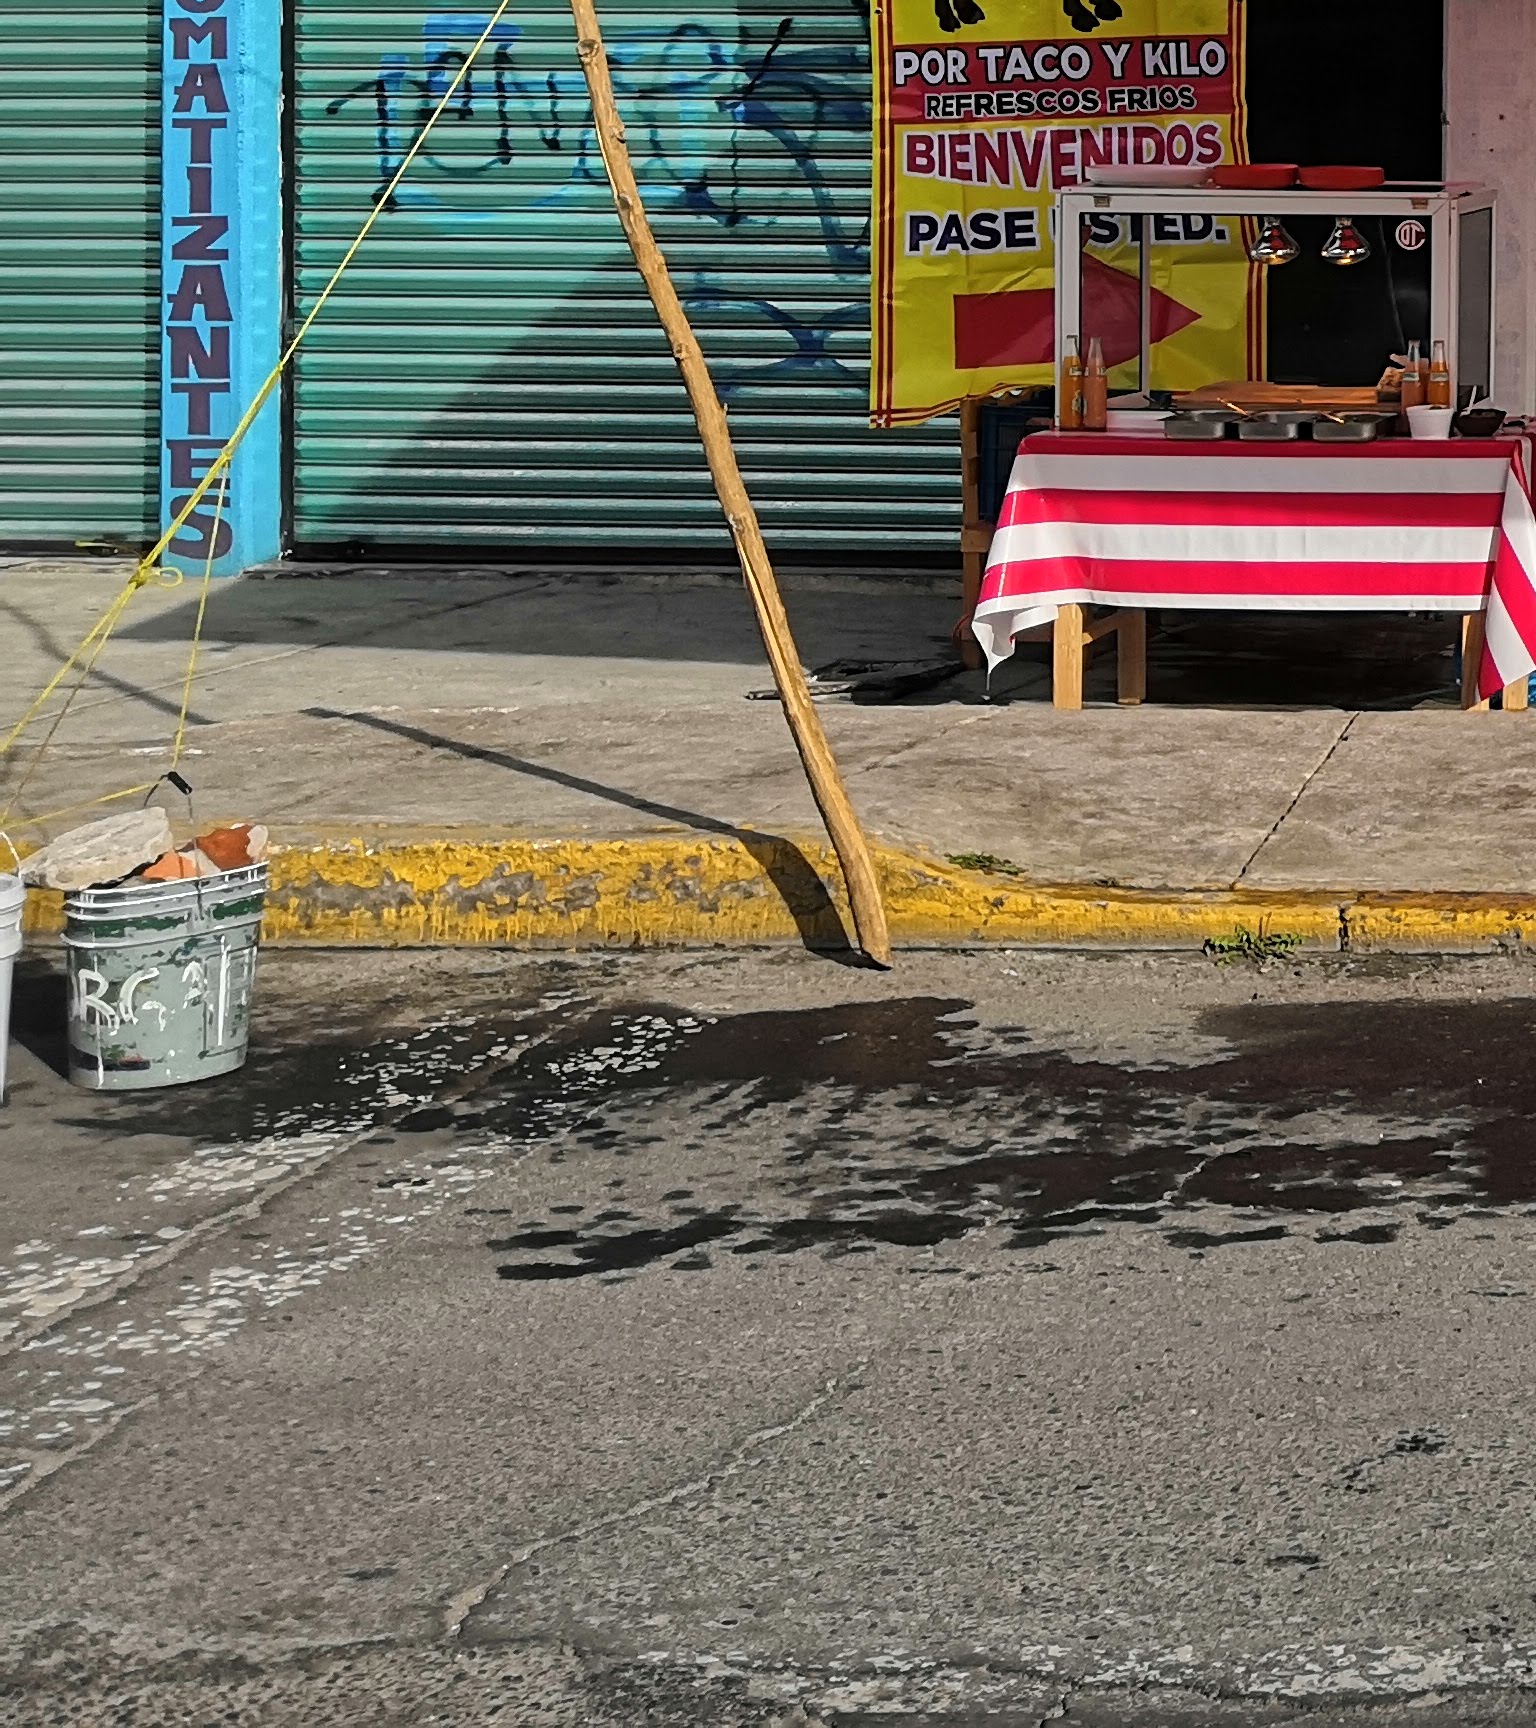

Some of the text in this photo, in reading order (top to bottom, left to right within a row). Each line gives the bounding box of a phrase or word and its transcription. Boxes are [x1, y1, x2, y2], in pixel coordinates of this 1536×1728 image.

[894, 40, 1227, 86] POR TACO Y KILO
[926, 86, 1196, 119] REFRESCOS FRIOS
[906, 124, 1222, 190] BIENVENIDOS
[908, 210, 1037, 252] PASE
